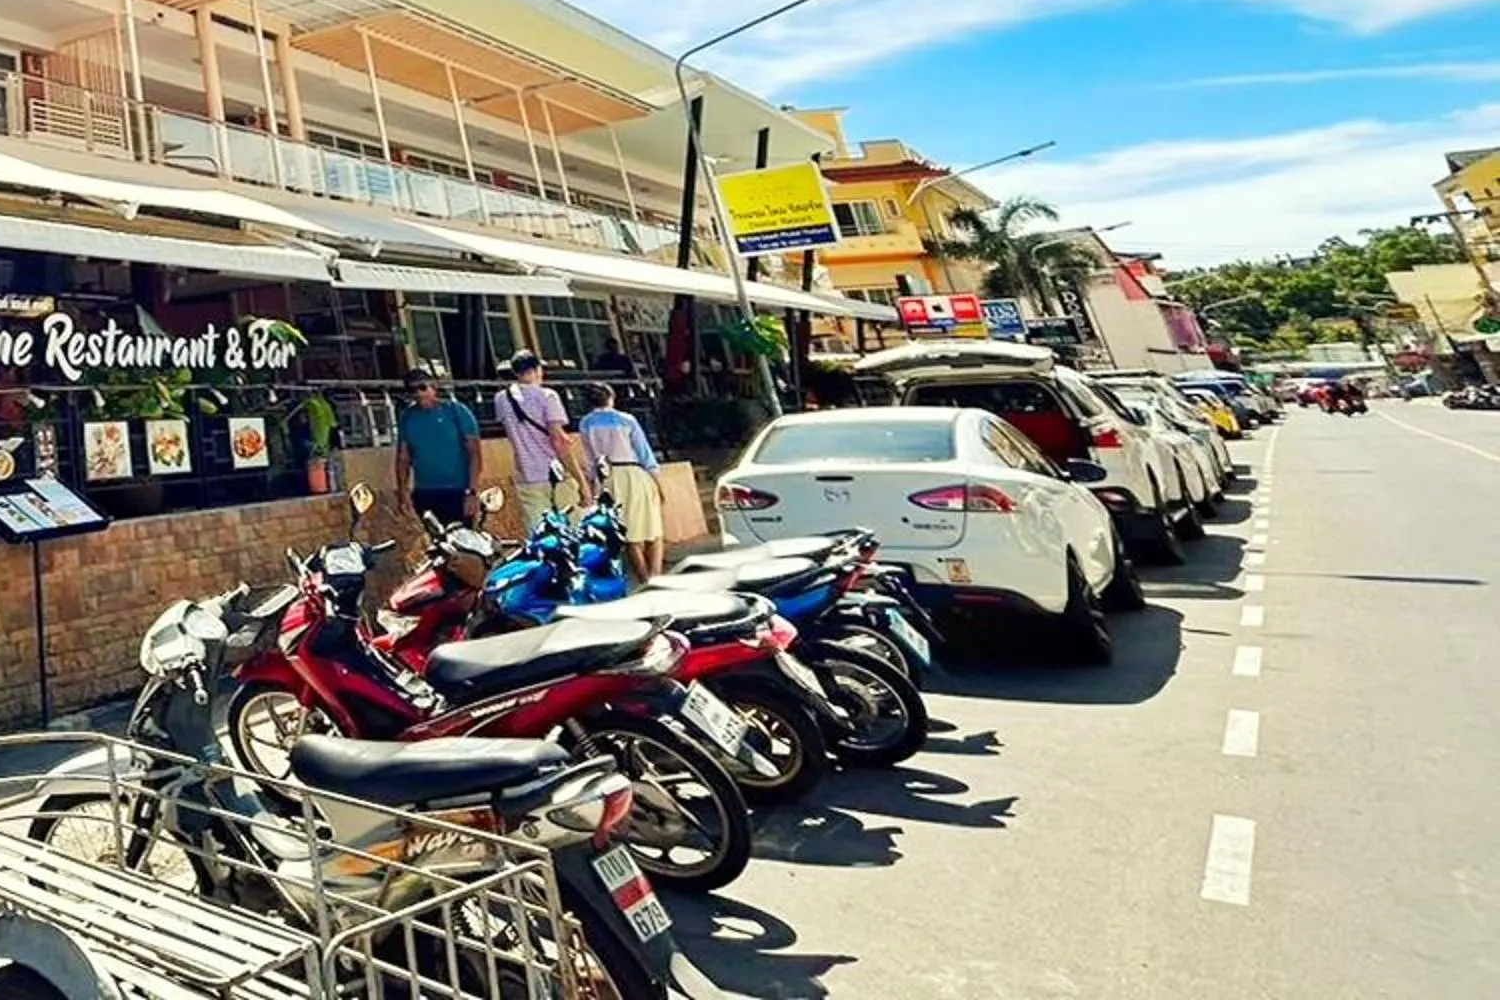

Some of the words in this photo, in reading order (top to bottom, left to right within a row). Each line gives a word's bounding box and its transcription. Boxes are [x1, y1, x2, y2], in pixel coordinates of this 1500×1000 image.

[43, 311, 218, 381] Restaurant
[225, 329, 246, 369] &
[248, 317, 297, 370] Bar
